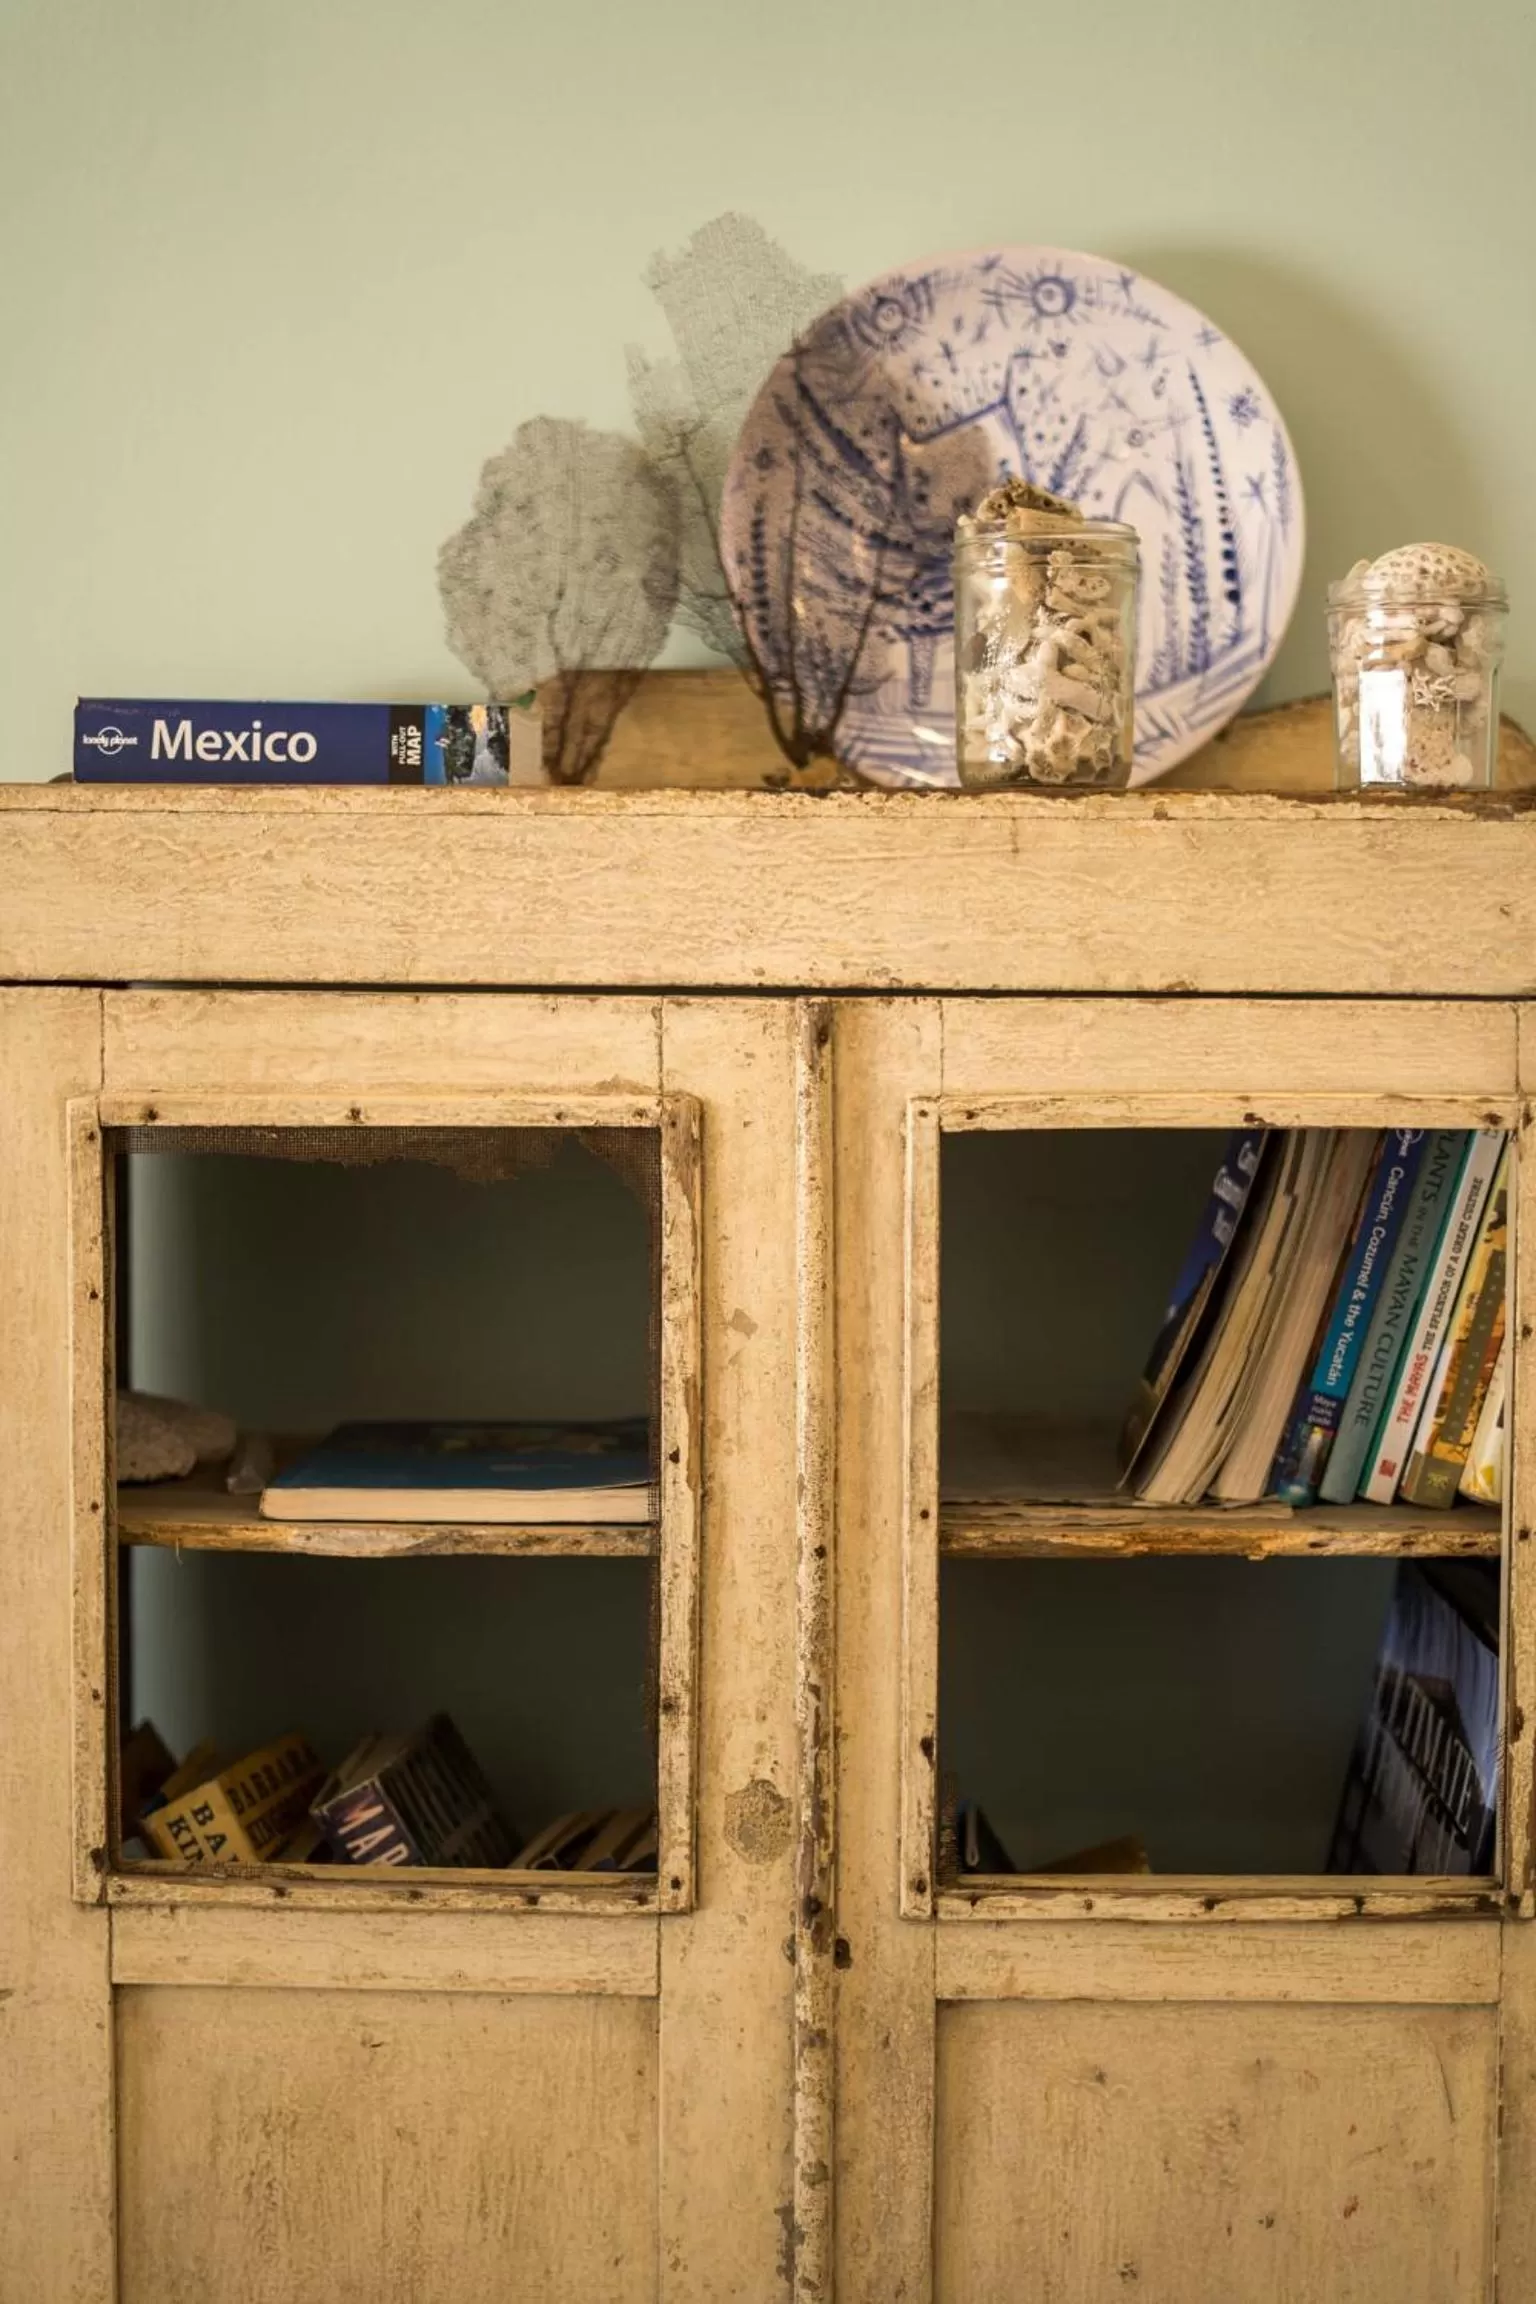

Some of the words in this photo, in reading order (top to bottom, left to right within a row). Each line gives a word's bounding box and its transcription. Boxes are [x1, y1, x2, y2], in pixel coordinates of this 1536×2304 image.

[151, 719, 318, 762] Mexico
[391, 734, 399, 757] WITH
[399, 726, 407, 765] PULL-OUT
[406, 725, 421, 765] MAP
[1462, 1176, 1483, 1221] CULTURE
[1357, 1226, 1386, 1291] Cozumel
[1452, 1221, 1470, 1255] GREAT
[1352, 1289, 1368, 1302] &
[1384, 1253, 1418, 1328] MAYAN
[1429, 1278, 1451, 1332] SPLENDOR
[1343, 1302, 1363, 1327] the
[1325, 1329, 1355, 1387] Yucatán
[1422, 1330, 1437, 1351] THE
[1355, 1333, 1393, 1427] CULTURE
[1406, 1353, 1428, 1397] MAYAS
[1397, 1390, 1414, 1424] THE
